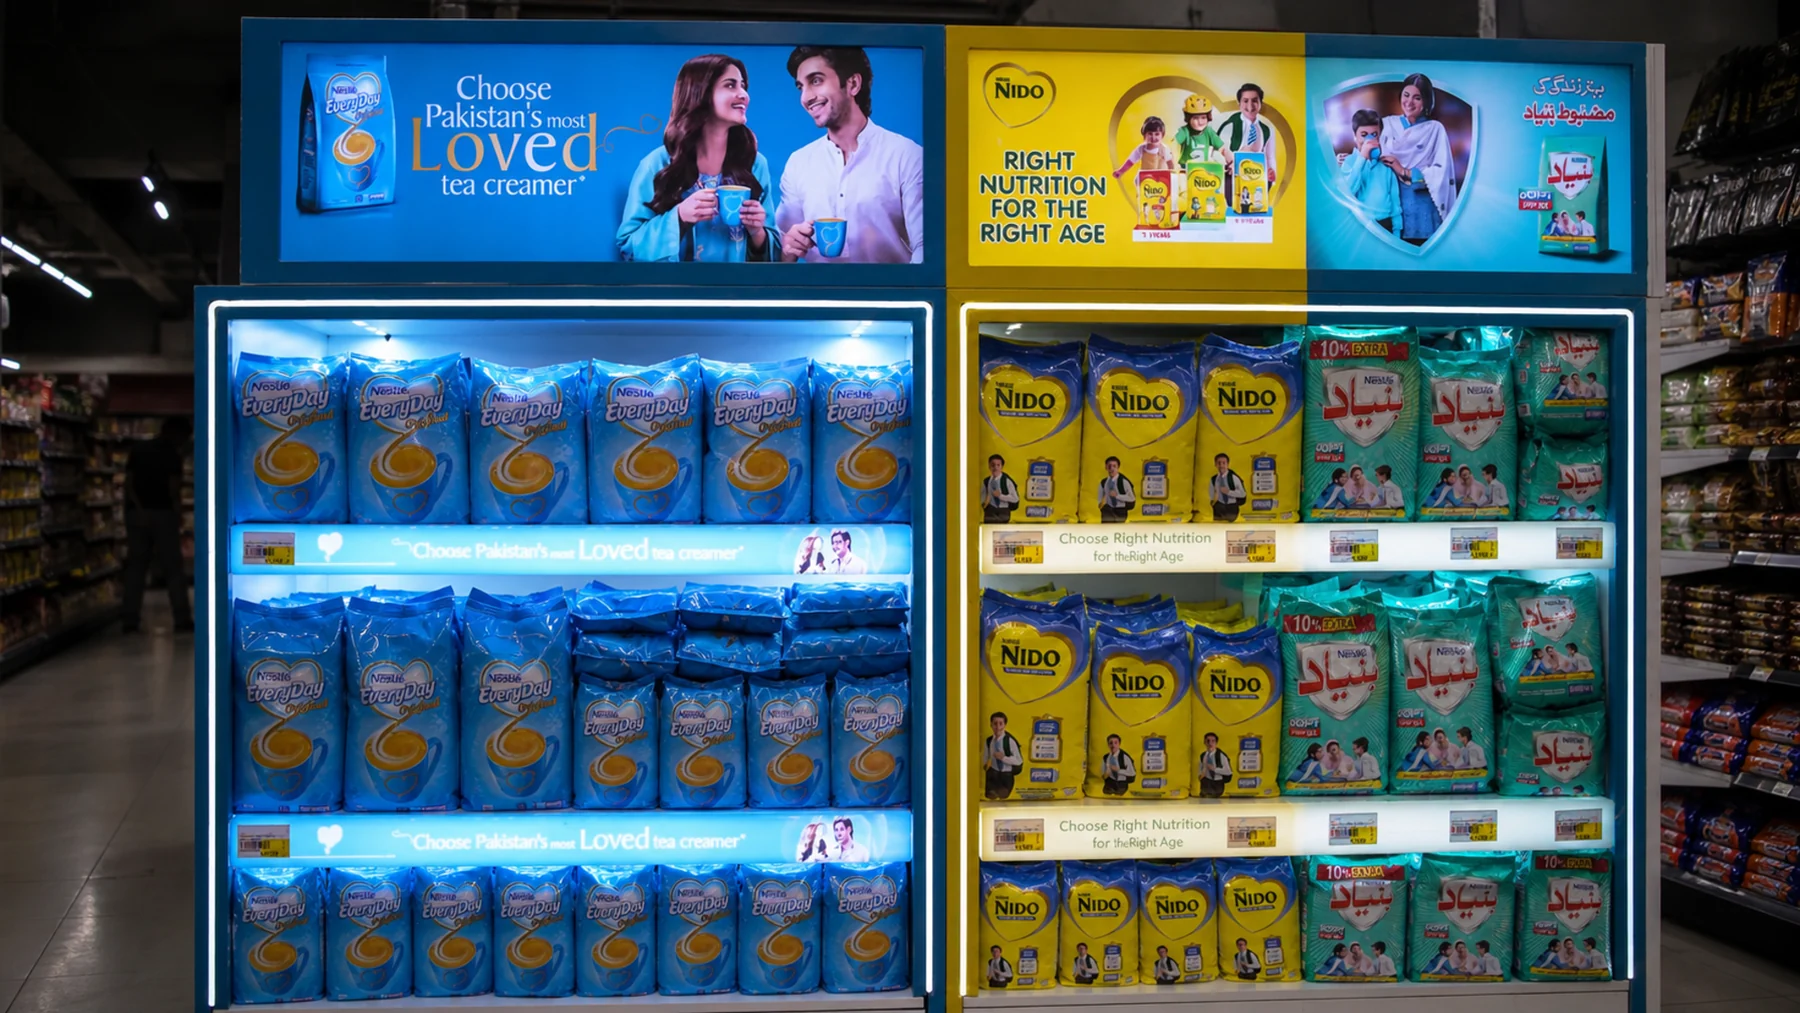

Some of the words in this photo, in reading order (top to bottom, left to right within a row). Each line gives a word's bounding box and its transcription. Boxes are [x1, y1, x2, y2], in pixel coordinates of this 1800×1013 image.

[456, 74, 551, 100] Choose
[995, 82, 1044, 99] NIDO
[326, 92, 380, 114] EveryDay
[426, 102, 542, 128] Pakistan's
[547, 114, 586, 128] most
[412, 112, 598, 172] Loved
[1004, 151, 1075, 170] RIGHT
[441, 175, 476, 196] tea
[980, 175, 1106, 196] NUTRITION
[991, 199, 1036, 218] FOR
[1044, 199, 1088, 218] THE
[980, 224, 1052, 243] RIGHT
[1059, 224, 1105, 244] AGE
[1352, 343, 1388, 356] EXTRA
[242, 388, 328, 417] EveryDay
[360, 392, 444, 420] EveryDay
[995, 388, 1055, 410] NIDO
[1111, 391, 1169, 411] NIDO
[1218, 388, 1276, 408] NIDO
[480, 400, 562, 426] EveryDay
[605, 397, 688, 422] EveryDay
[714, 398, 798, 426] EveryDay
[827, 398, 907, 423] EveryDay
[413, 542, 472, 560] Choose
[476, 542, 548, 559] Pakistan's
[578, 537, 649, 560] Loved
[652, 547, 674, 560] tea
[1059, 532, 1108, 544] Choose
[1114, 532, 1148, 547] Right
[1152, 532, 1212, 544] Nutrition
[1094, 550, 1111, 562] for
[1160, 550, 1184, 564] Age
[1001, 645, 1060, 667] NIDO
[246, 681, 324, 703] EveryDay
[478, 679, 552, 705] EveryDay
[1112, 673, 1164, 691] NIDO
[1210, 674, 1261, 692] NIDO
[360, 680, 435, 706] EveryDay
[584, 717, 644, 736] EveryDay
[670, 718, 732, 737] EveryDay
[760, 716, 818, 736] EveryDay
[844, 713, 903, 732] EveryDay
[1060, 820, 1108, 832] Choose
[1114, 820, 1148, 834] Right
[1152, 818, 1210, 830] Nutrition
[413, 833, 472, 850] Choose
[476, 833, 548, 850] Pakistan's
[550, 840, 576, 850] most
[580, 826, 650, 850] Loved
[653, 836, 676, 849] tea
[1093, 837, 1110, 848] for
[1160, 836, 1184, 850] Age
[1326, 866, 1351, 880] 10%
[995, 901, 1039, 915] NIDO
[1078, 898, 1120, 912] NIDO
[1156, 899, 1199, 914] NIDO
[1234, 891, 1277, 907] NIDO
